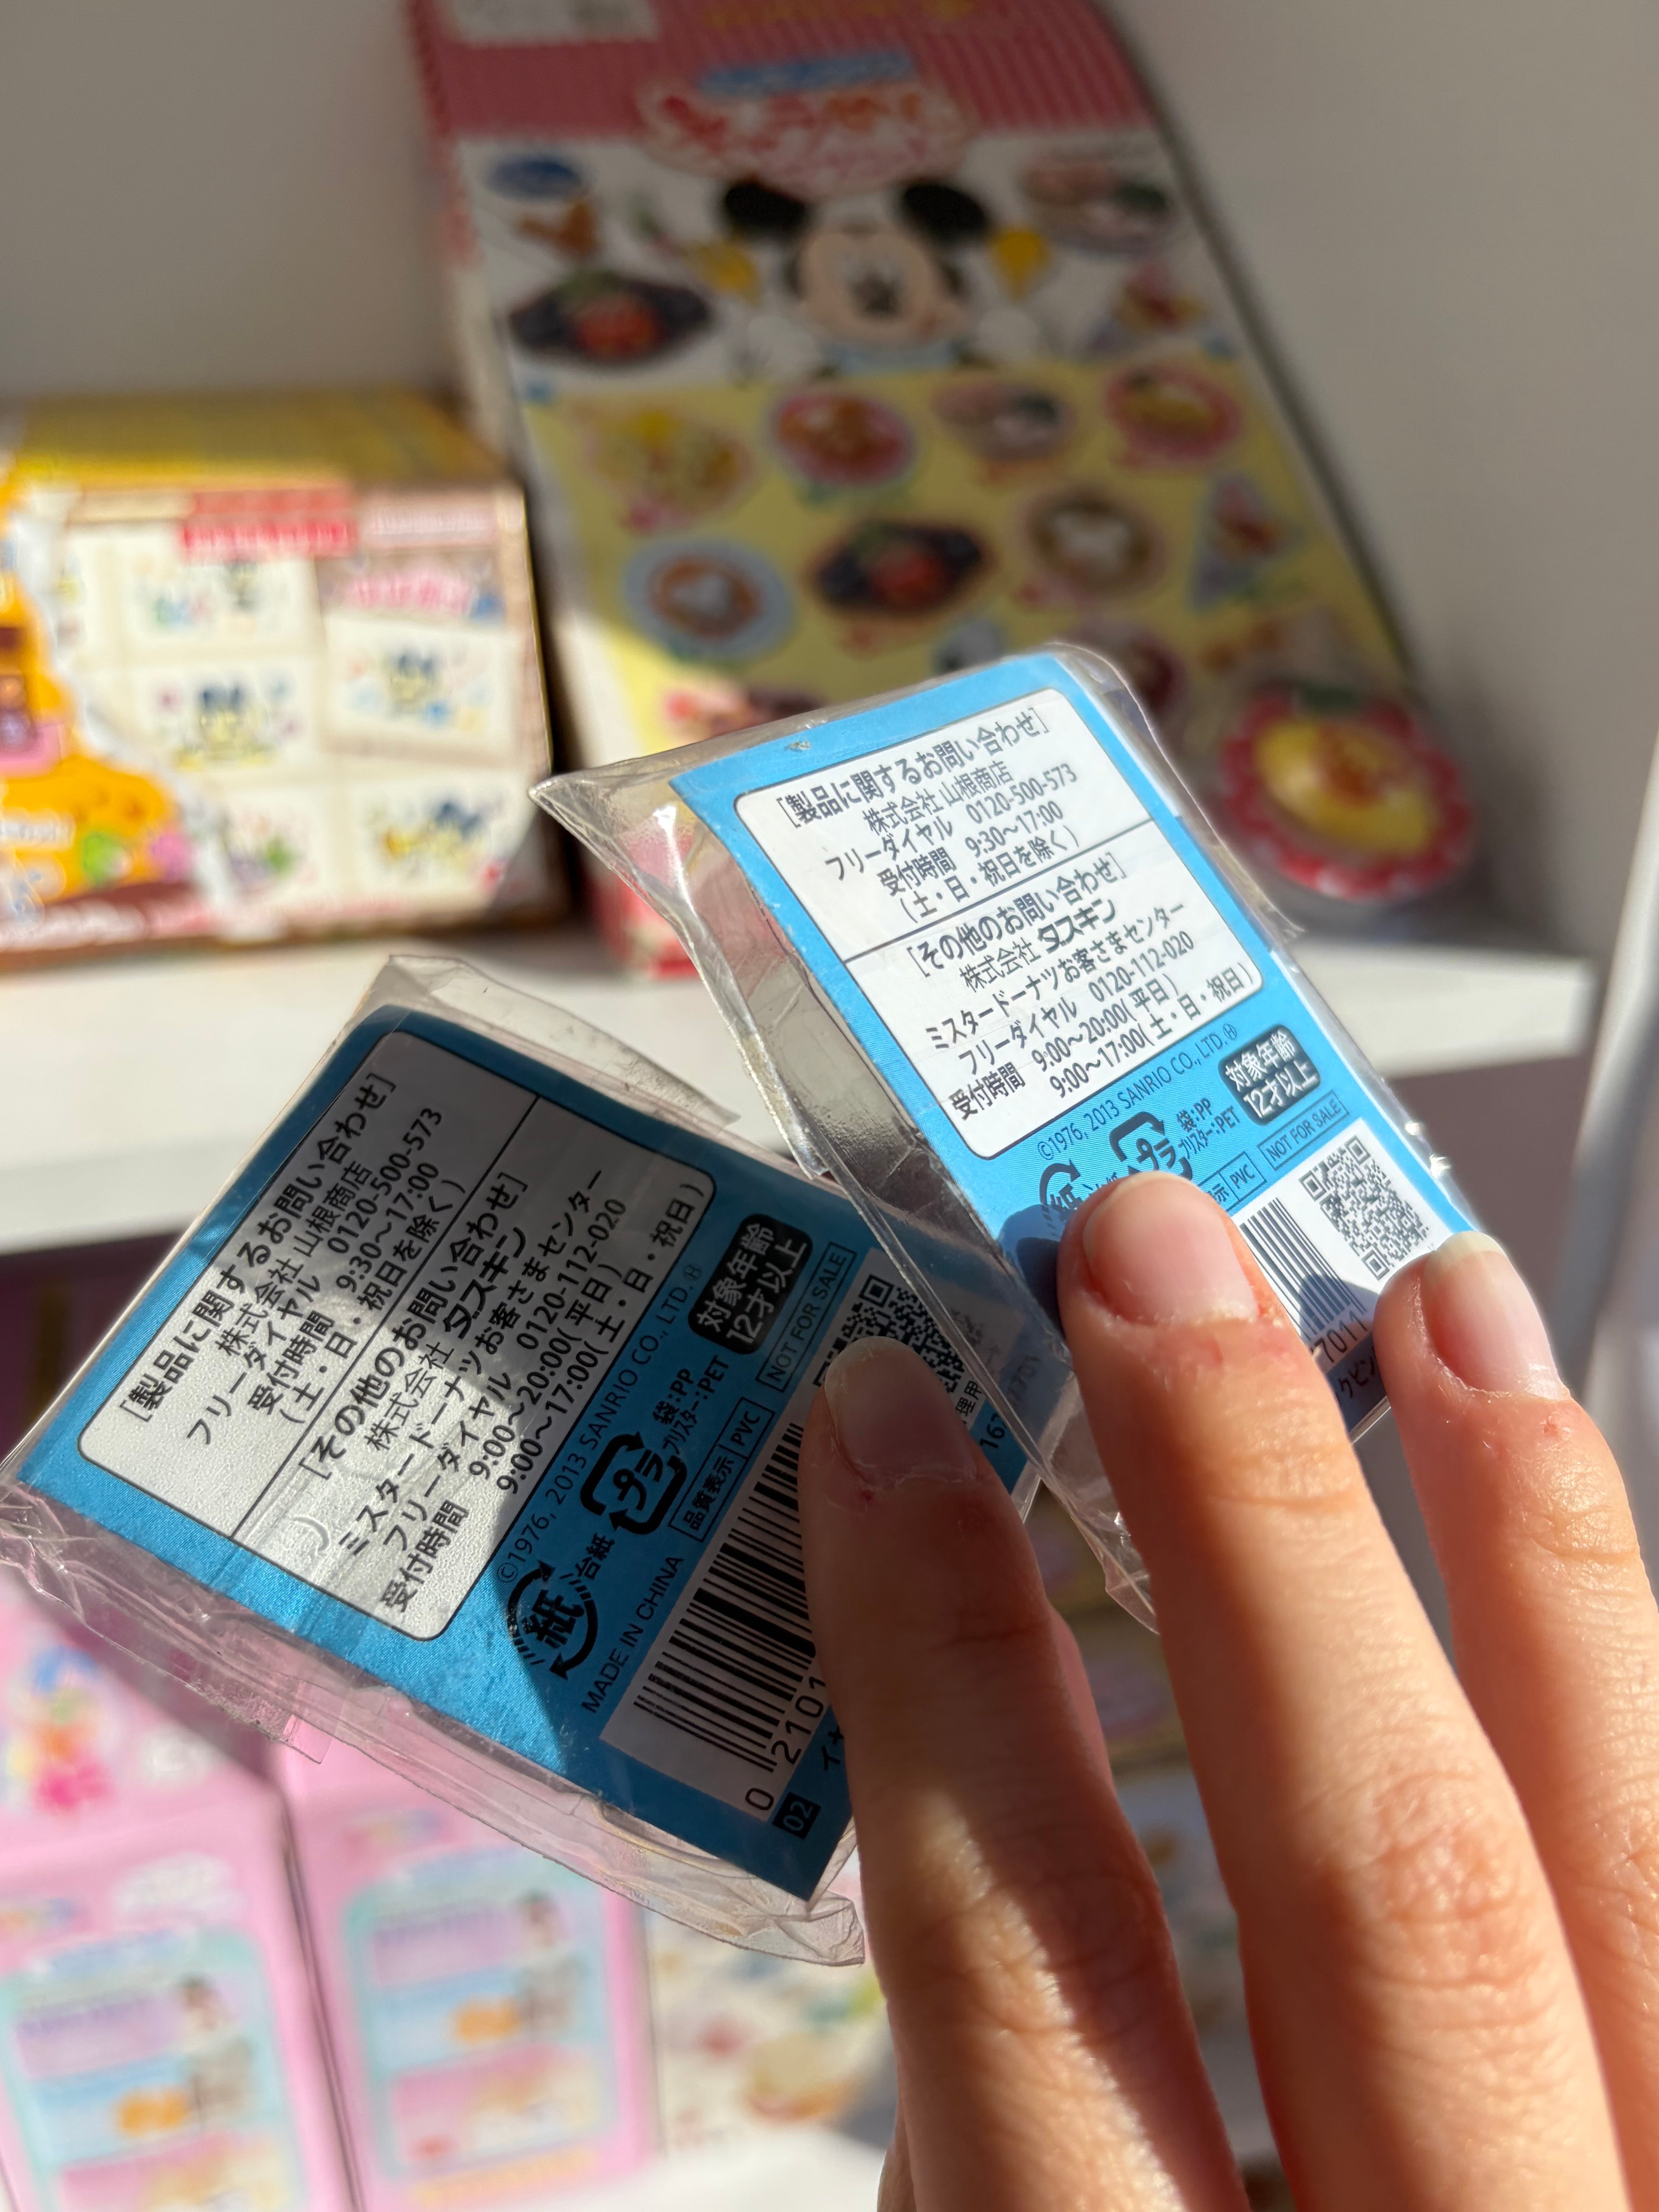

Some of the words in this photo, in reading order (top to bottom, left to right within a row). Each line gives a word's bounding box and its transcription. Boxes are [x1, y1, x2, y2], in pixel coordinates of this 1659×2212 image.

[825, 818, 952, 880] フリーダイヤル
[966, 763, 1077, 823] 0120-500-573
[877, 847, 957, 896] 受付時間
[926, 903, 1184, 1049] ミスタードーナツお客さまセンター
[959, 997, 1077, 1076] フリーダイヤル
[1088, 931, 1195, 1003] 0120-112-020
[951, 1064, 1025, 1121] 受付時間
[1083, 1099, 1121, 1131] 2013
[1121, 1064, 1171, 1111] SANRIO
[1224, 1029, 1296, 1093] 対象年齢
[1243, 1058, 1319, 1118] 12才以上
[1266, 1135, 1293, 1162] NOT
[1292, 1122, 1316, 1144] FOR
[1312, 1101, 1340, 1128] SALE
[1230, 1163, 1255, 1189] PVC
[187, 1274, 321, 1445] フリーダイヤル
[327, 1107, 442, 1253] 0120-500-573
[697, 1222, 776, 1332] 対象年齢
[726, 1239, 808, 1344] 12才以上
[765, 1344, 795, 1383] NOT
[791, 1303, 820, 1342] FOR
[813, 1252, 848, 1298] SALE
[1310, 1310, 1368, 1363] 7011
[248, 1310, 335, 1415] 受付時間
[339, 1170, 602, 1556] ミスタードーナツお客さまセンター
[383, 1372, 512, 1551] フリーダイヤル
[518, 1198, 626, 1351] 0120-112-020
[554, 1454, 588, 1506] 2013
[581, 1367, 639, 1451] SANRIO
[730, 1410, 761, 1447] PVC
[611, 1448, 664, 1512] プラ
[683, 1456, 736, 1531] 品質表示
[380, 1500, 468, 1612] 受付時間
[574, 1533, 617, 1581] 台紙
[522, 1589, 585, 1649] 紙
[581, 1647, 629, 1714] MADE
[621, 1624, 644, 1647] IN
[636, 1556, 684, 1621] CHINA
[781, 1799, 814, 1831] 02
